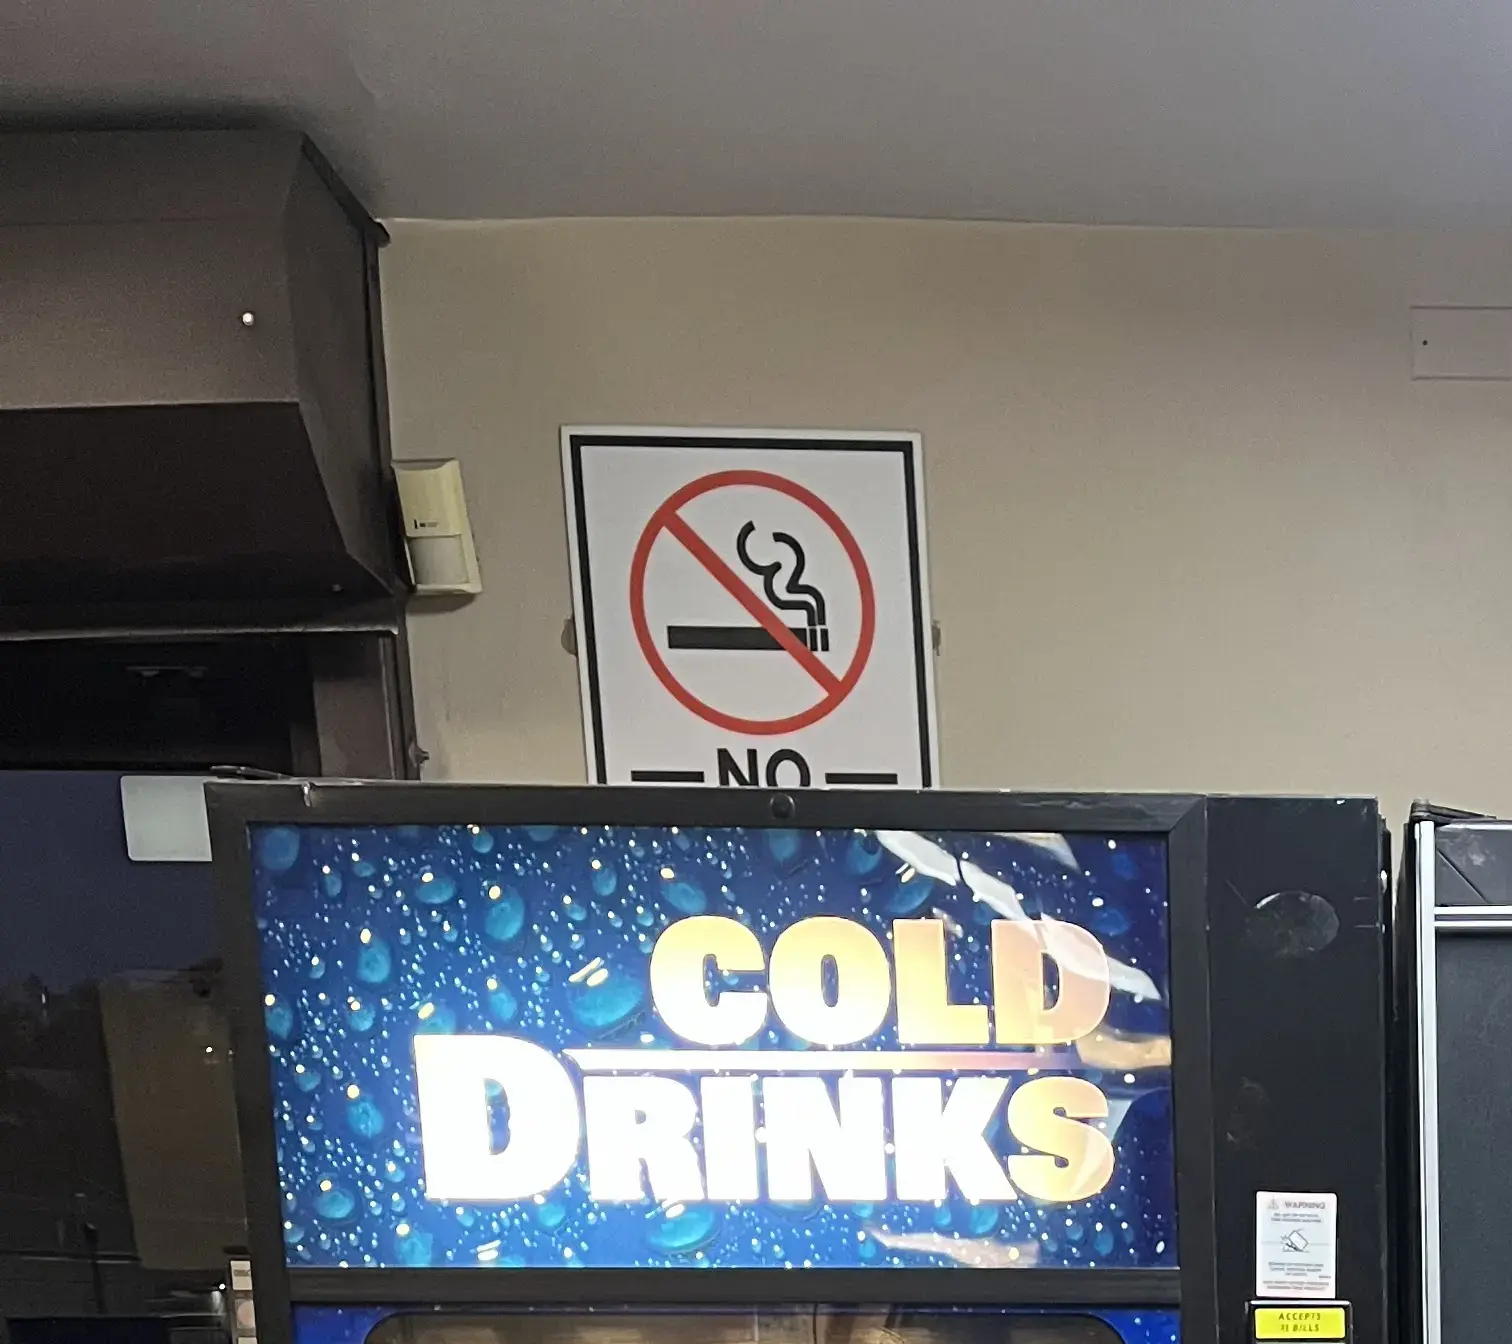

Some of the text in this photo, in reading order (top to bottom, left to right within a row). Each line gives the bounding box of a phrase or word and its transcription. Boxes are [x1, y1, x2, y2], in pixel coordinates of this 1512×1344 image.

[717, 748, 811, 787] NO
[649, 915, 1110, 1046] COLD
[413, 1034, 1116, 1202] DRINKS
